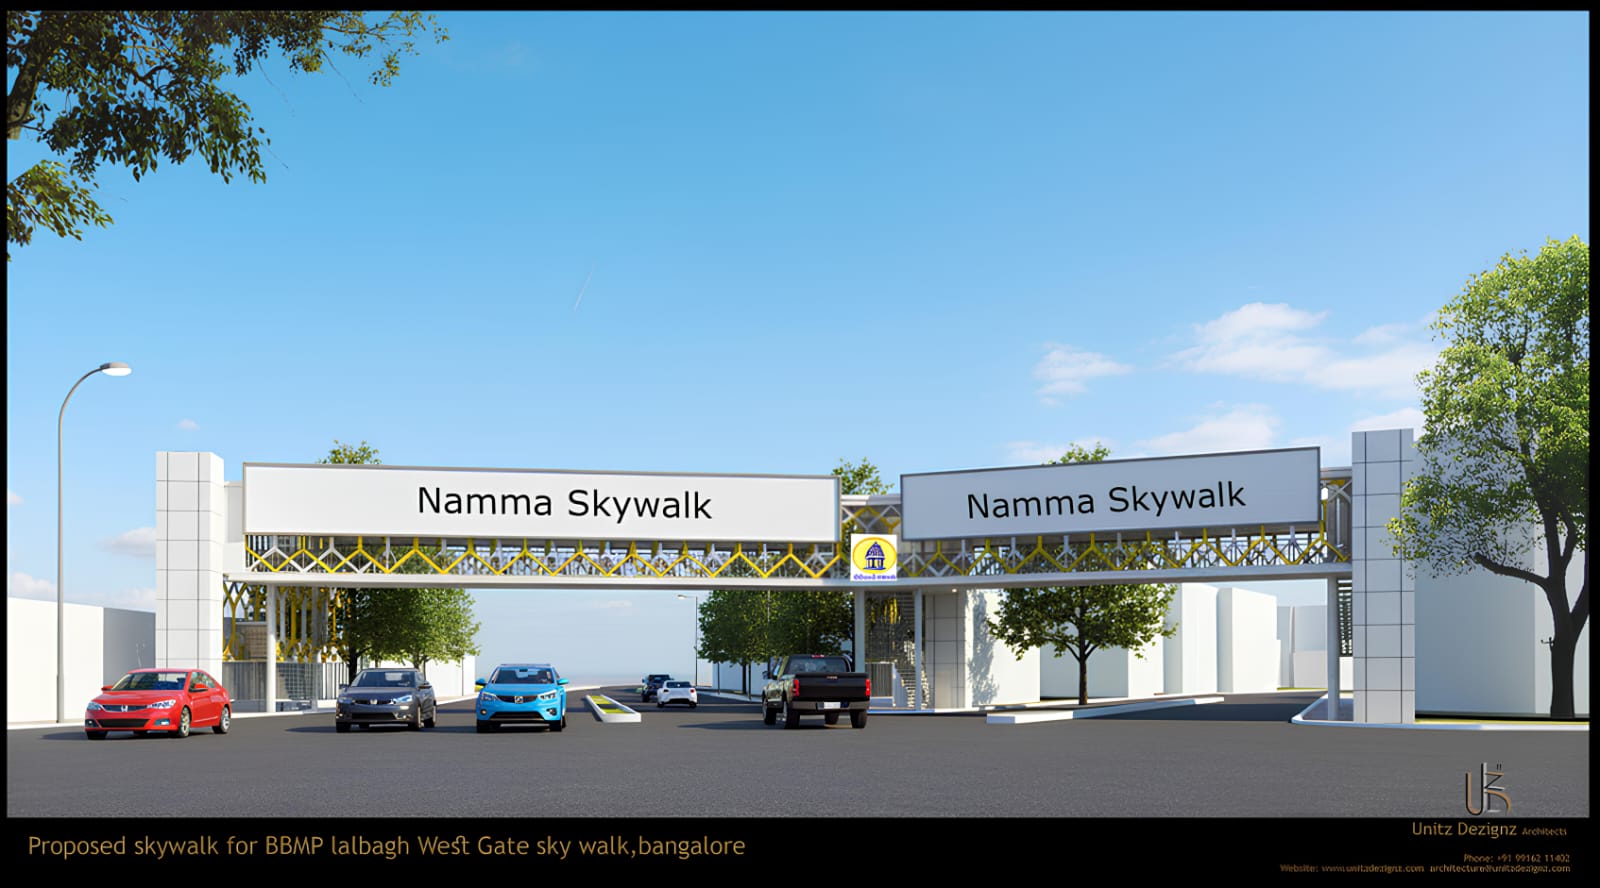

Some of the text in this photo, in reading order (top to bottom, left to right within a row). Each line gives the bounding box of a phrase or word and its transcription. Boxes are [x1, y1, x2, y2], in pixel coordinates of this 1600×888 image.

[419, 486, 713, 524] Namma Skywalk
[967, 481, 1247, 519] Namma Skywalk
